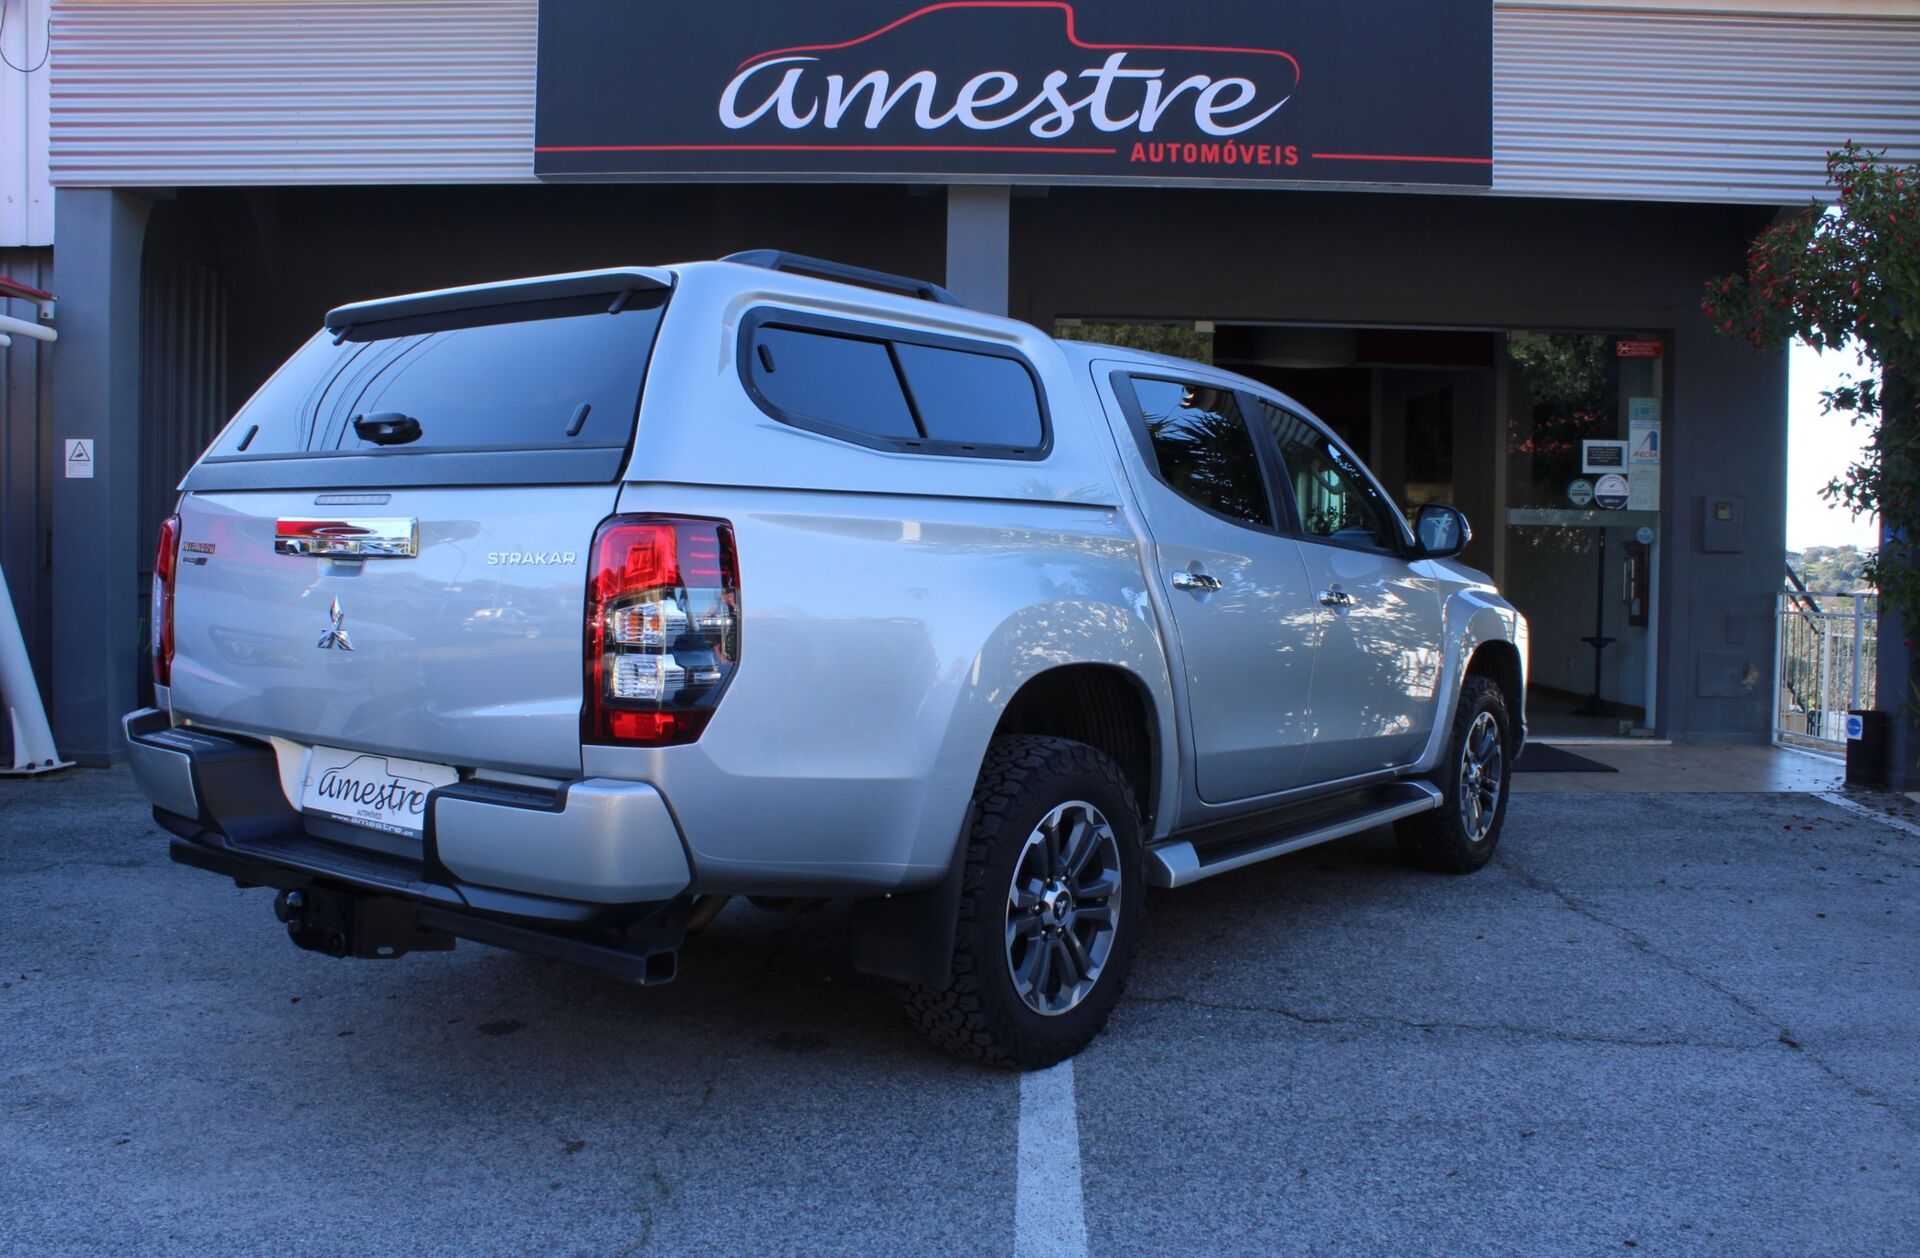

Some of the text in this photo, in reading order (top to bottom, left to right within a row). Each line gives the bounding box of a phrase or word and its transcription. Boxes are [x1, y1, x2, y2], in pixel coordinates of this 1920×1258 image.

[718, 52, 1291, 139] amestre
[1130, 140, 1299, 166] AUTOMÓVEIS
[487, 551, 577, 566] STRAKAR
[318, 771, 425, 814] amestre
